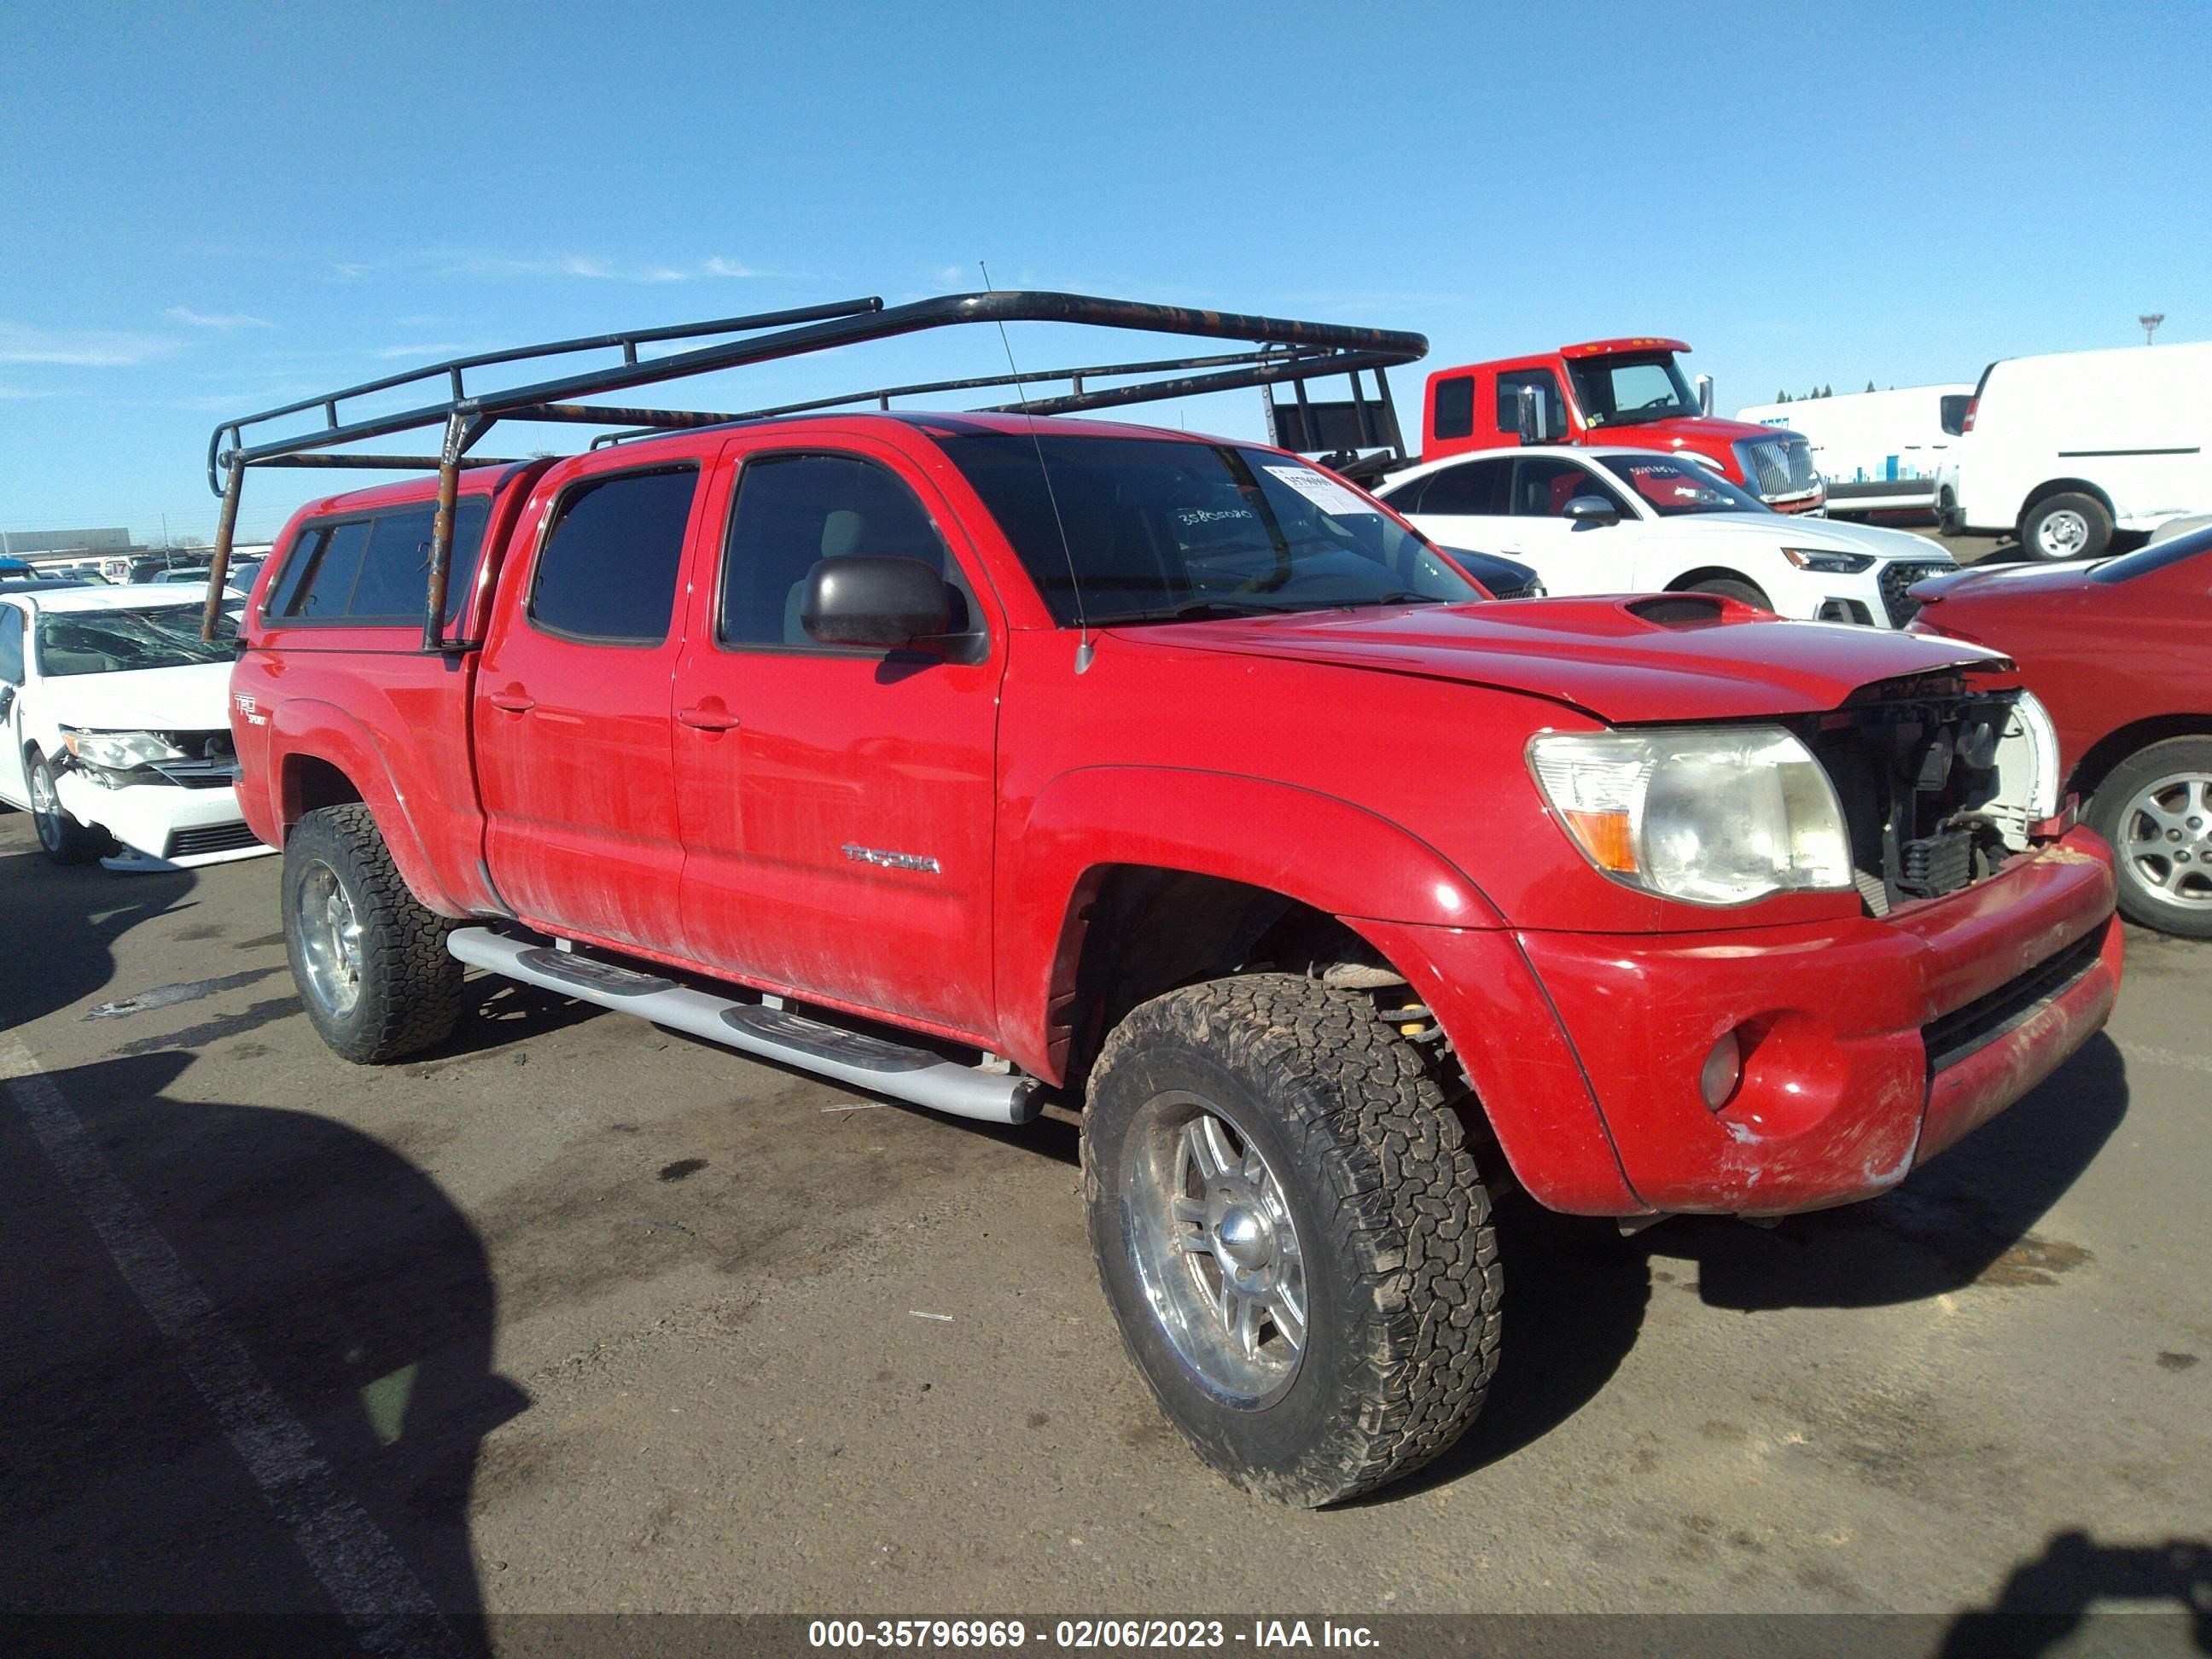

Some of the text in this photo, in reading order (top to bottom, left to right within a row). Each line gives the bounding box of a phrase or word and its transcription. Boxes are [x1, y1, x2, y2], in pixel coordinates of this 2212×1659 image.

[113, 563, 127, 574] 17
[233, 692, 256, 715] TRD
[841, 843, 942, 875] TACOMA
